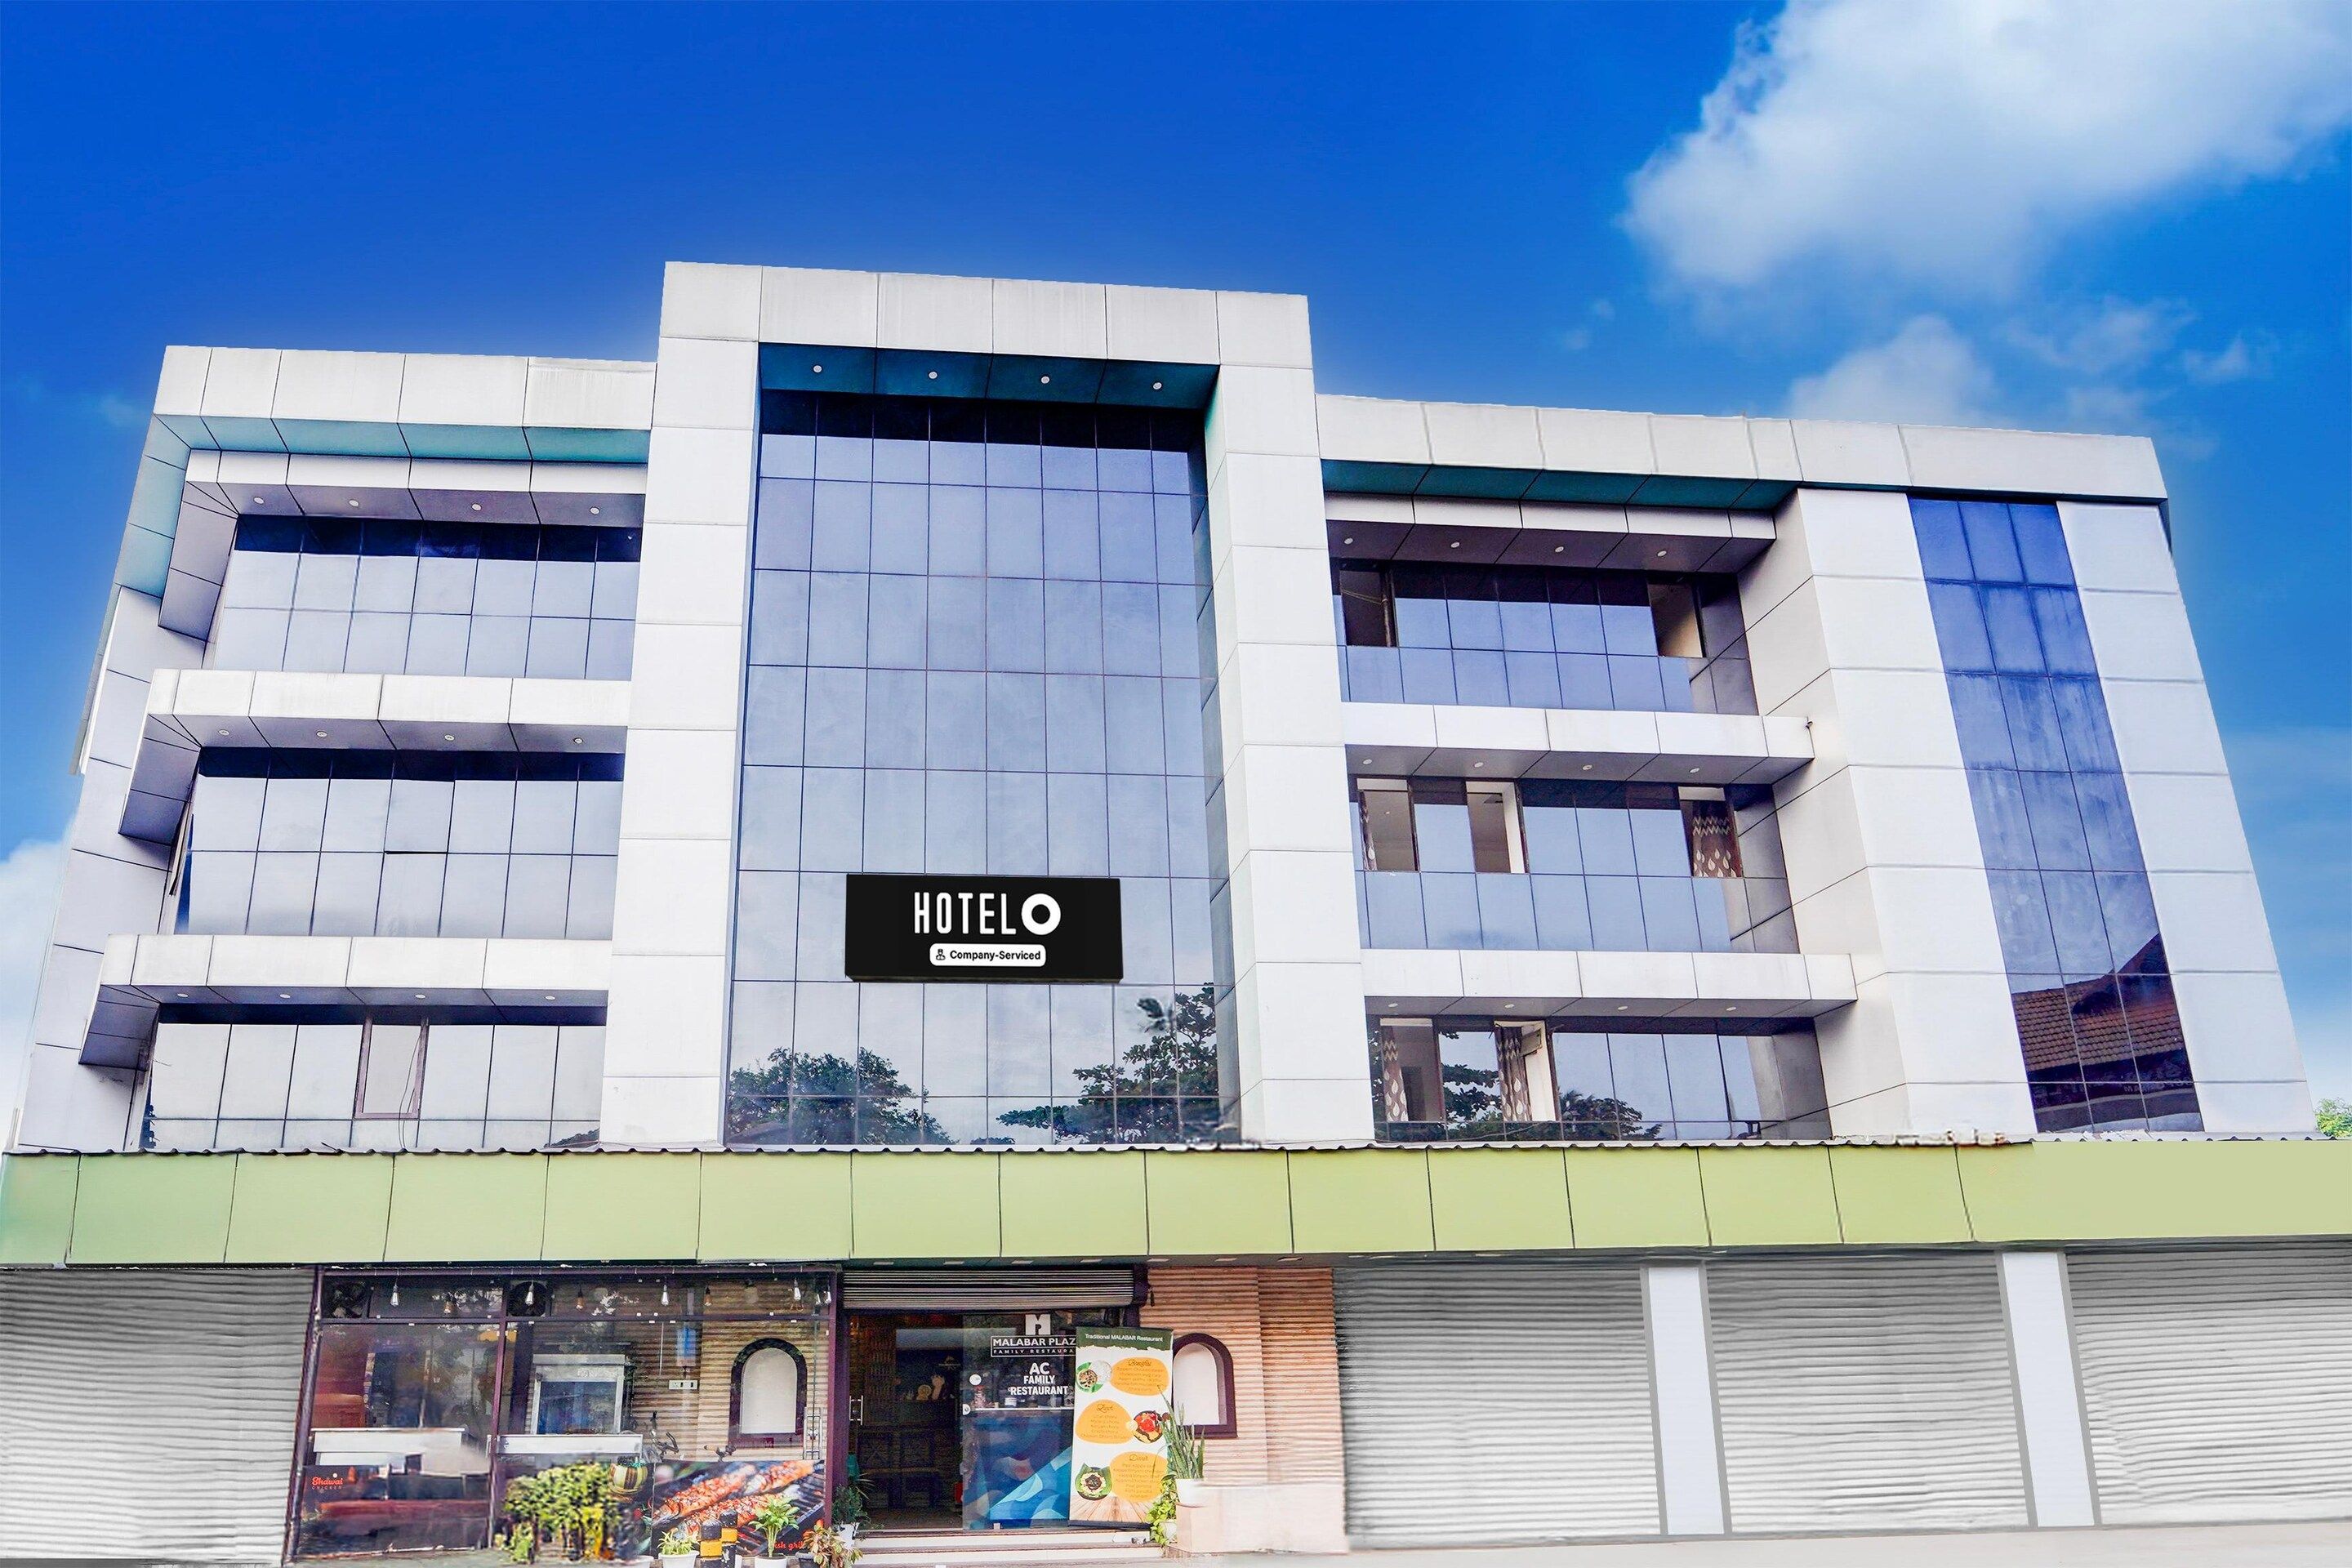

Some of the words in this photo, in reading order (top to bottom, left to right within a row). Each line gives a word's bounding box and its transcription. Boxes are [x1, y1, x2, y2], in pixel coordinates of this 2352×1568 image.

[914, 892, 1017, 934] HOTEL
[1021, 893, 1062, 935] O
[950, 950, 1041, 962] Company-Serviced
[993, 1338, 1046, 1347] MALABAR
[1049, 1338, 1076, 1346] PLAZ
[1029, 1362, 1050, 1375] AC
[1023, 1375, 1056, 1384] FAMILY
[1010, 1386, 1069, 1396] RESTAURANT
